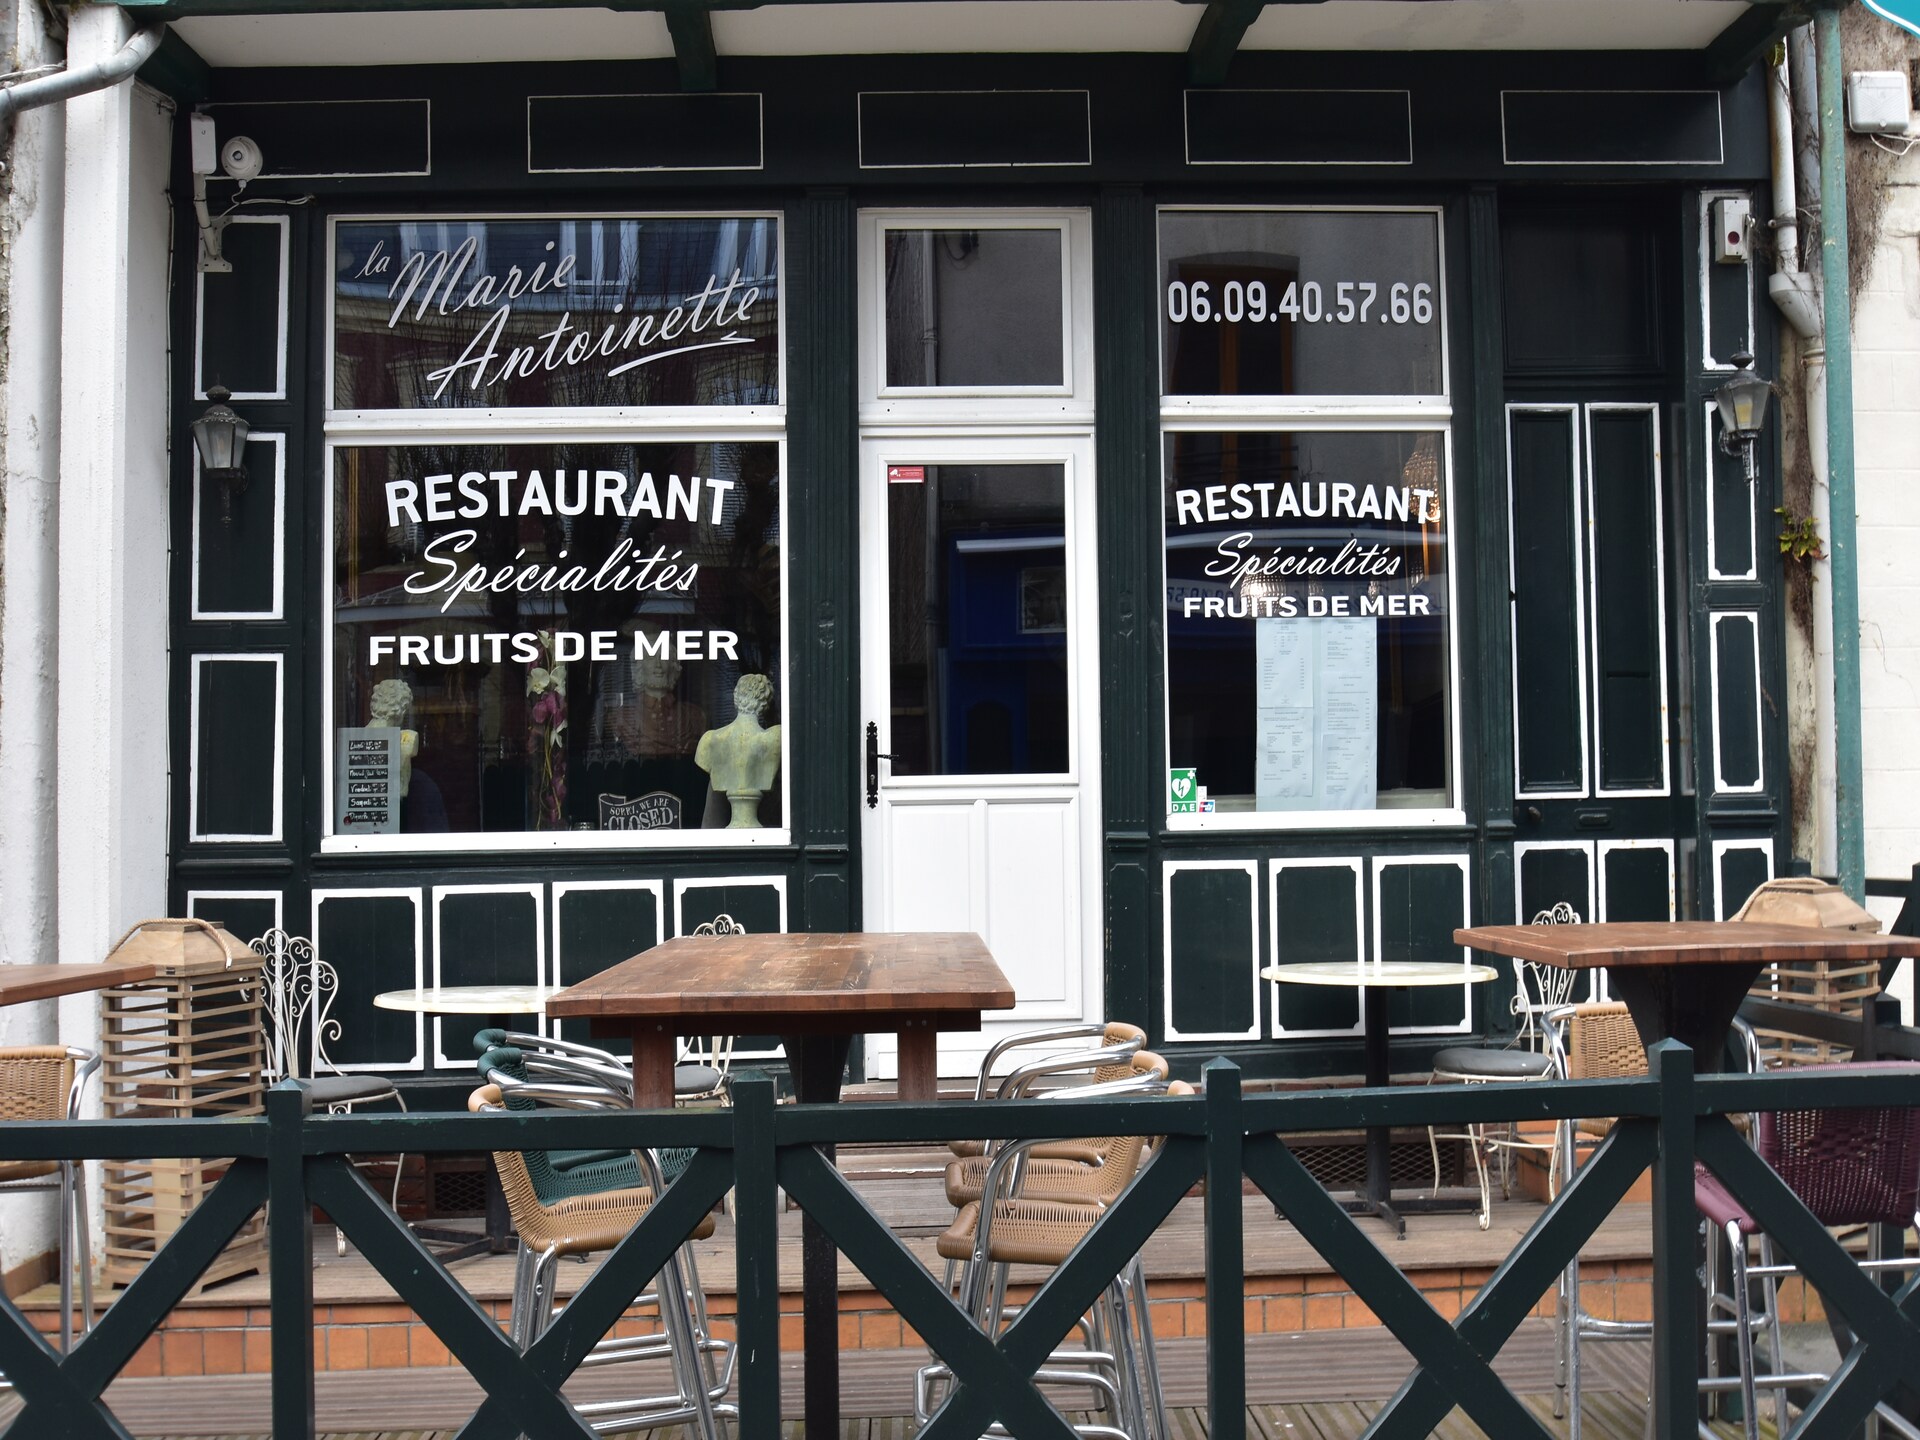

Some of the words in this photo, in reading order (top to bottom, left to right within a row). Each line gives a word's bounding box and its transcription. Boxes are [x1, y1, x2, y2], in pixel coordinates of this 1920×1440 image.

[355, 239, 391, 279] la
[388, 236, 576, 328] Marie
[1167, 280, 1433, 325] 06.09.40.57.66
[427, 268, 760, 400] Antoinette
[385, 469, 735, 527] RESTAURANT
[1175, 482, 1435, 526] RESTAURANT
[404, 529, 699, 614] Spécialités
[1204, 532, 1401, 589] Spécialités
[1183, 597, 1298, 618] FRUITS
[1307, 595, 1350, 617] DE
[1360, 594, 1430, 617] MER
[369, 633, 540, 666] FRUITS
[554, 631, 617, 662] DE
[634, 630, 739, 661] MER
[608, 807, 673, 830] CLOSED
[1172, 804, 1196, 812] DAE
